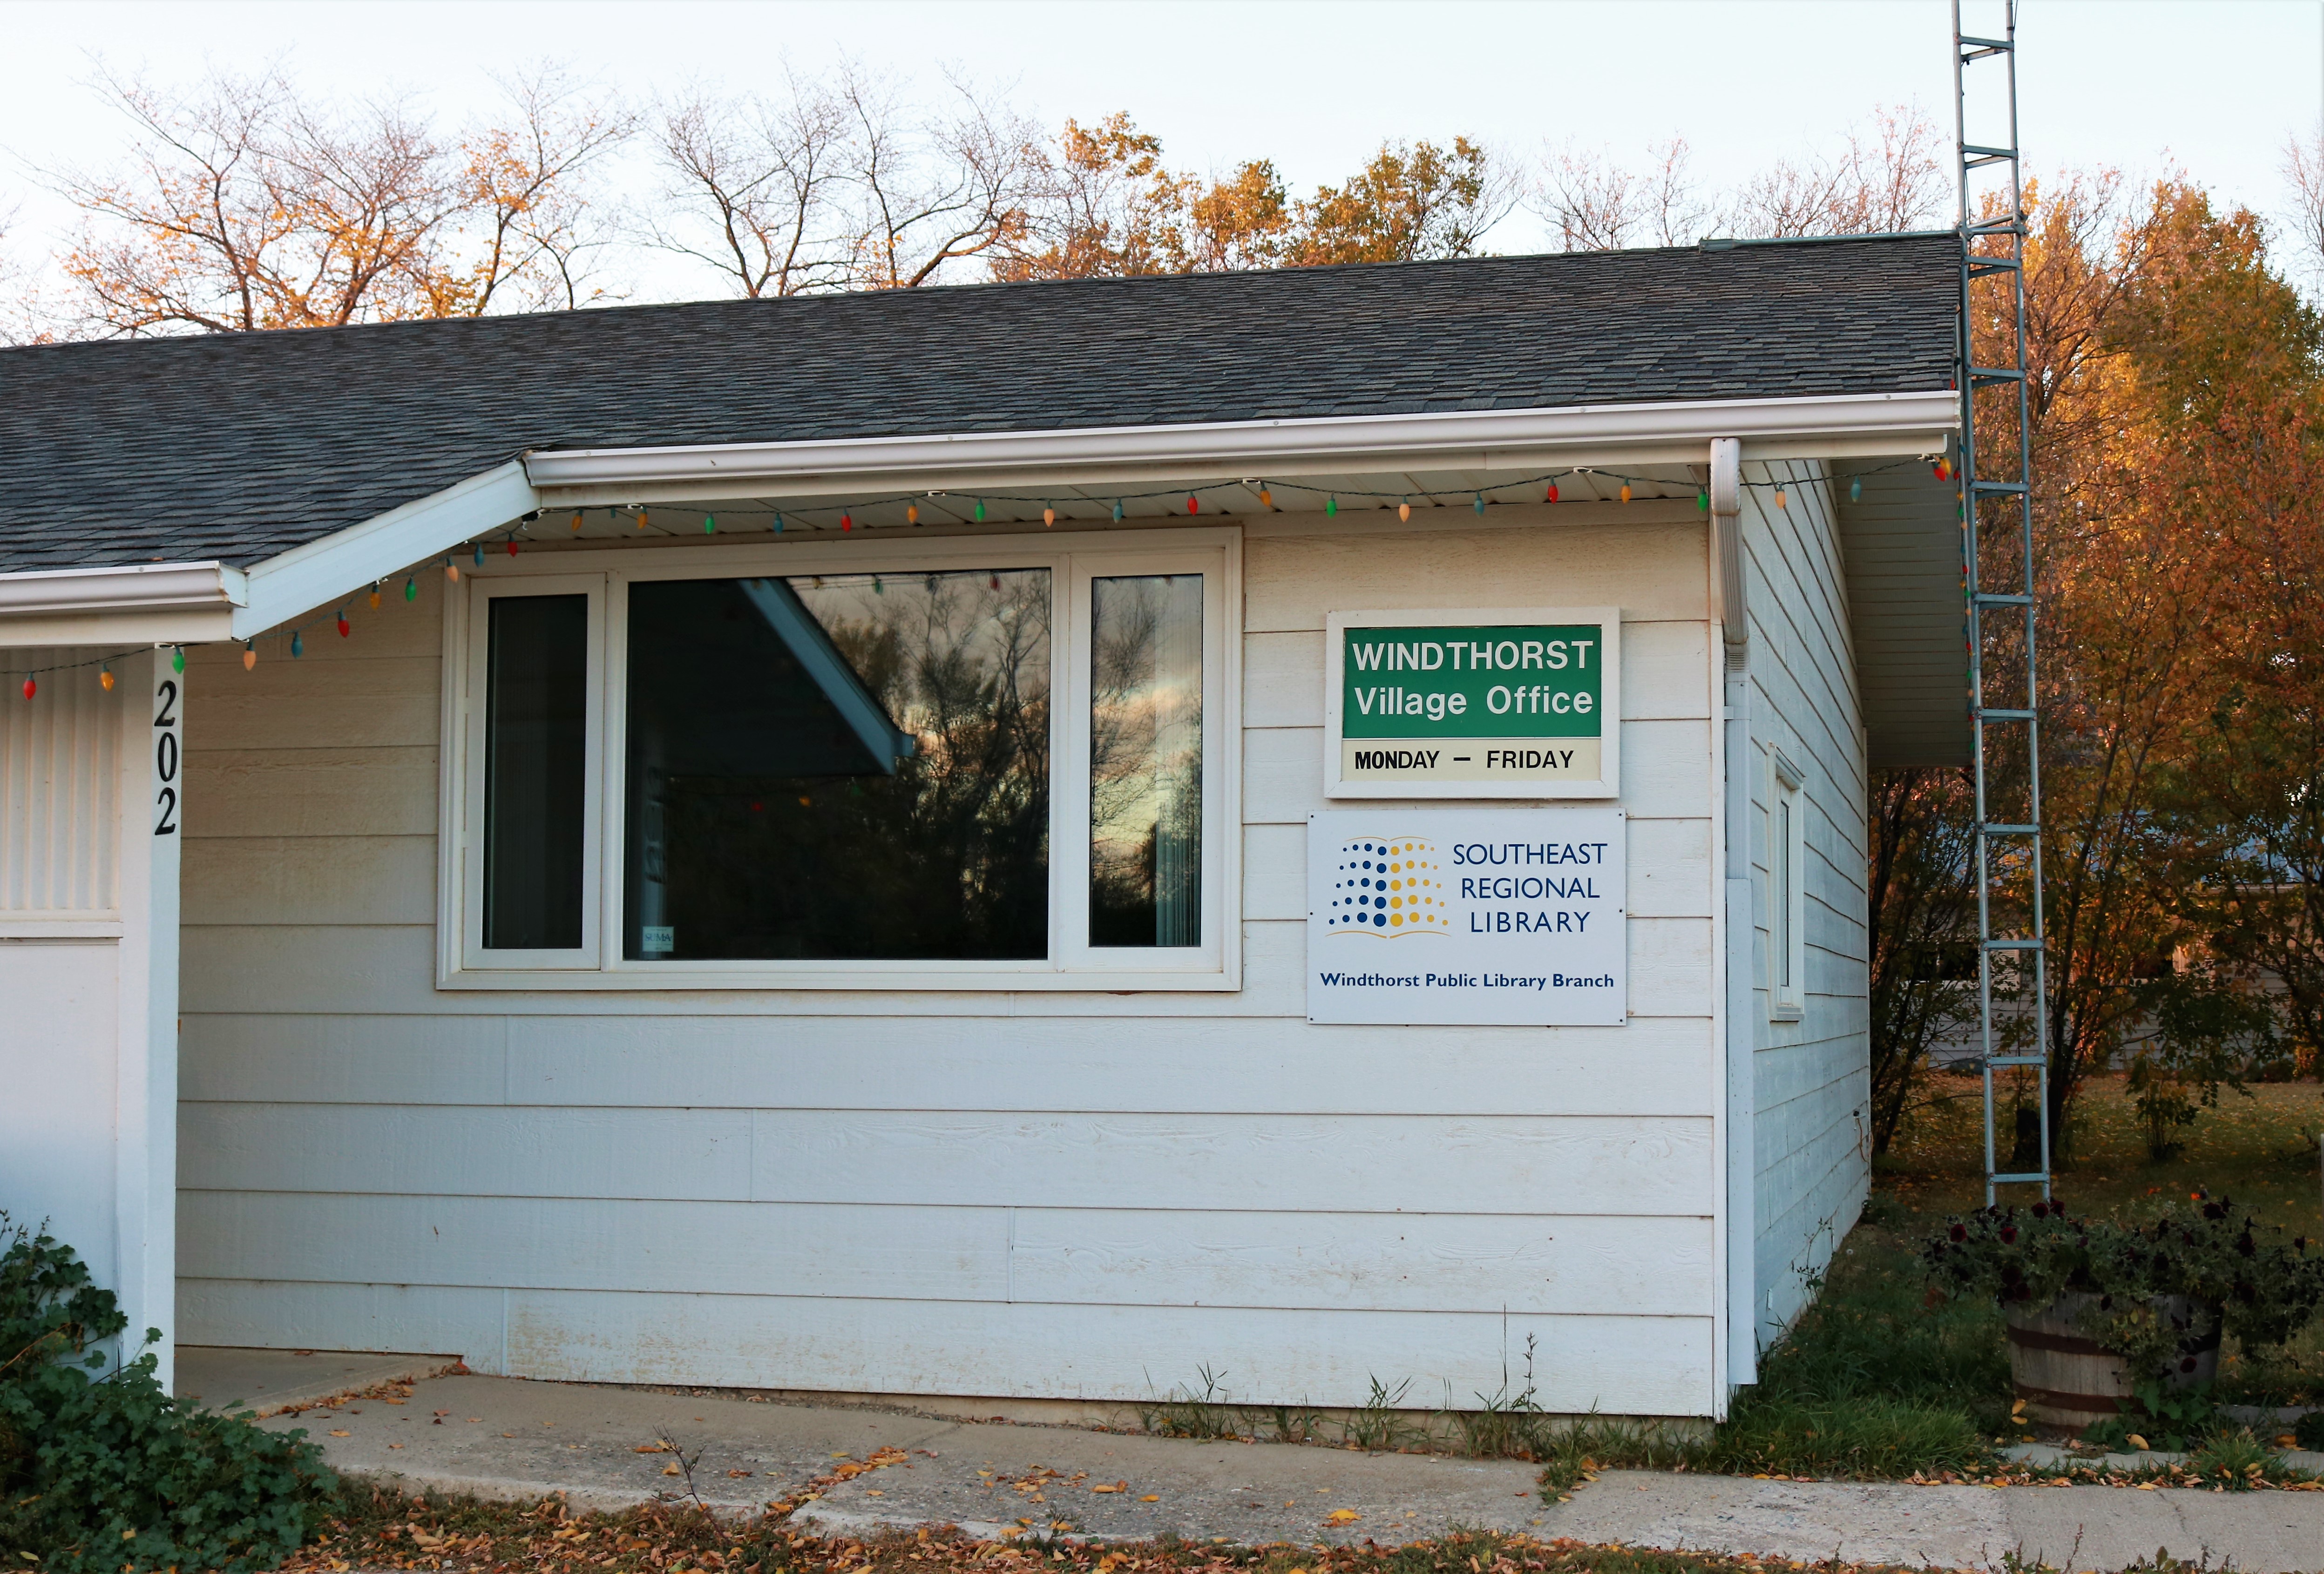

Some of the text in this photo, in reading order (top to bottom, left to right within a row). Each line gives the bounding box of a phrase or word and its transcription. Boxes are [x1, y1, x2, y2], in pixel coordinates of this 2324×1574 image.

[1352, 641, 1593, 671] WINDTHORST
[1354, 685, 1592, 721] Village Office
[154, 680, 178, 836] 202
[1355, 750, 1440, 769] MONDAY
[1487, 750, 1574, 768] FRIDAY
[1453, 843, 1608, 865] SOUTHEAST
[1462, 877, 1600, 899] REGIONAL
[1471, 911, 1590, 933] LIBRARY
[1320, 973, 1614, 991] Windthorst Public Library Branch
